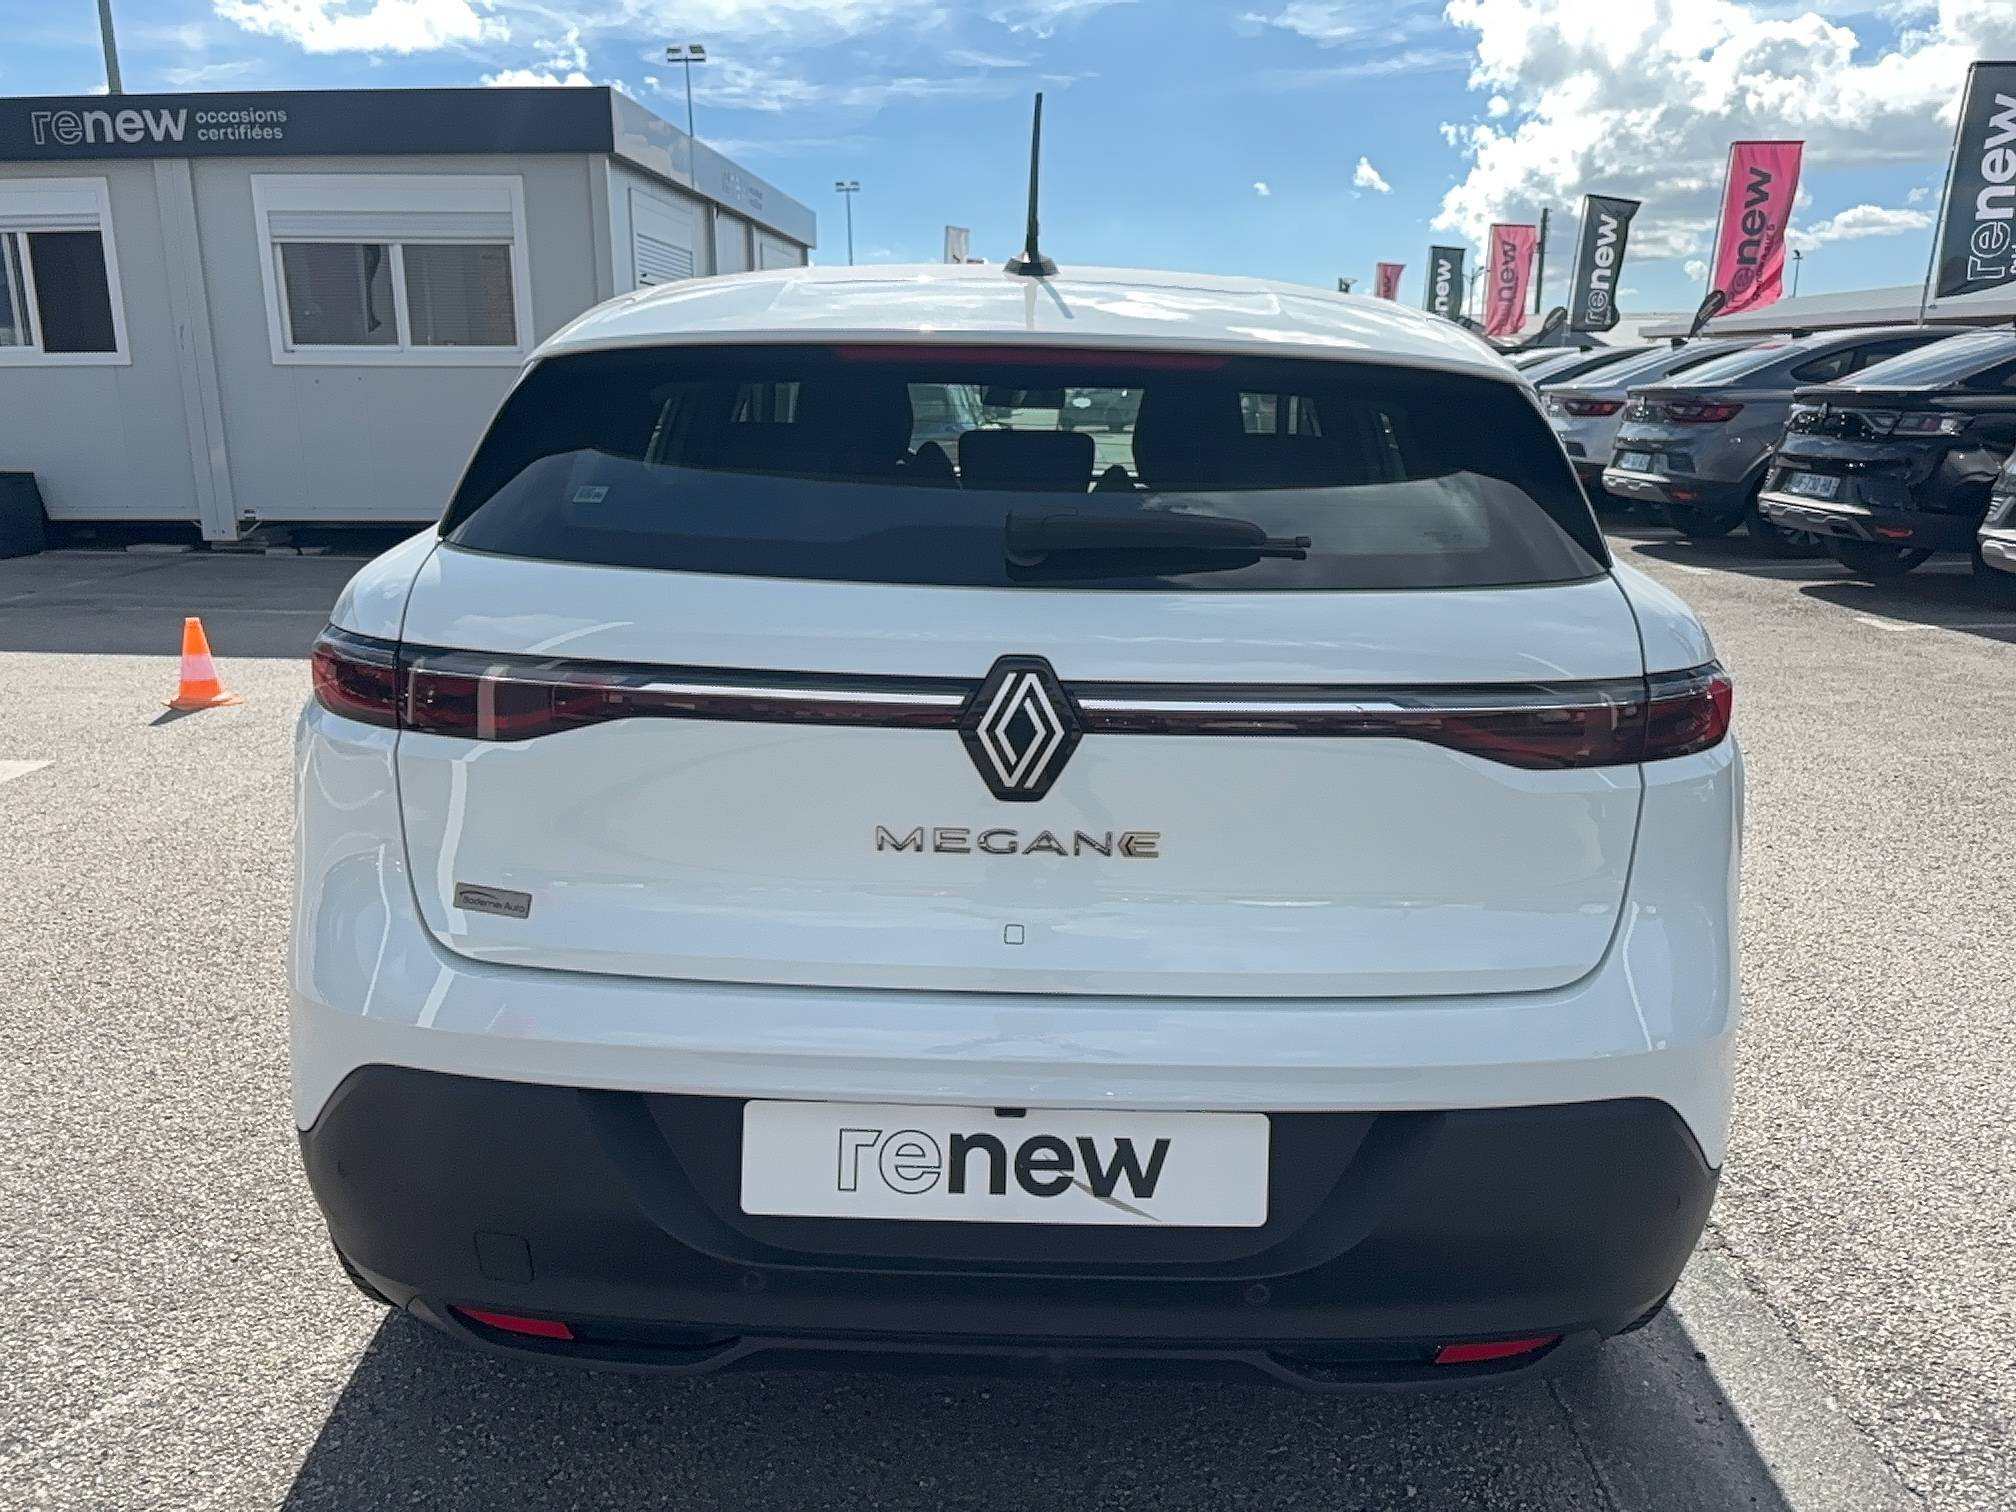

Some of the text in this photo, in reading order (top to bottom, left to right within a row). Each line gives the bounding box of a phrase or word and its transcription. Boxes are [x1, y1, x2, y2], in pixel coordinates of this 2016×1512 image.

[31, 108, 188, 145] renew
[195, 107, 287, 123] occasions
[197, 123, 283, 141] certifiées
[1967, 92, 2016, 281] renew
[1585, 213, 1618, 325] renew
[876, 825, 1161, 858] MEGANE
[837, 1128, 1172, 1199] renew
